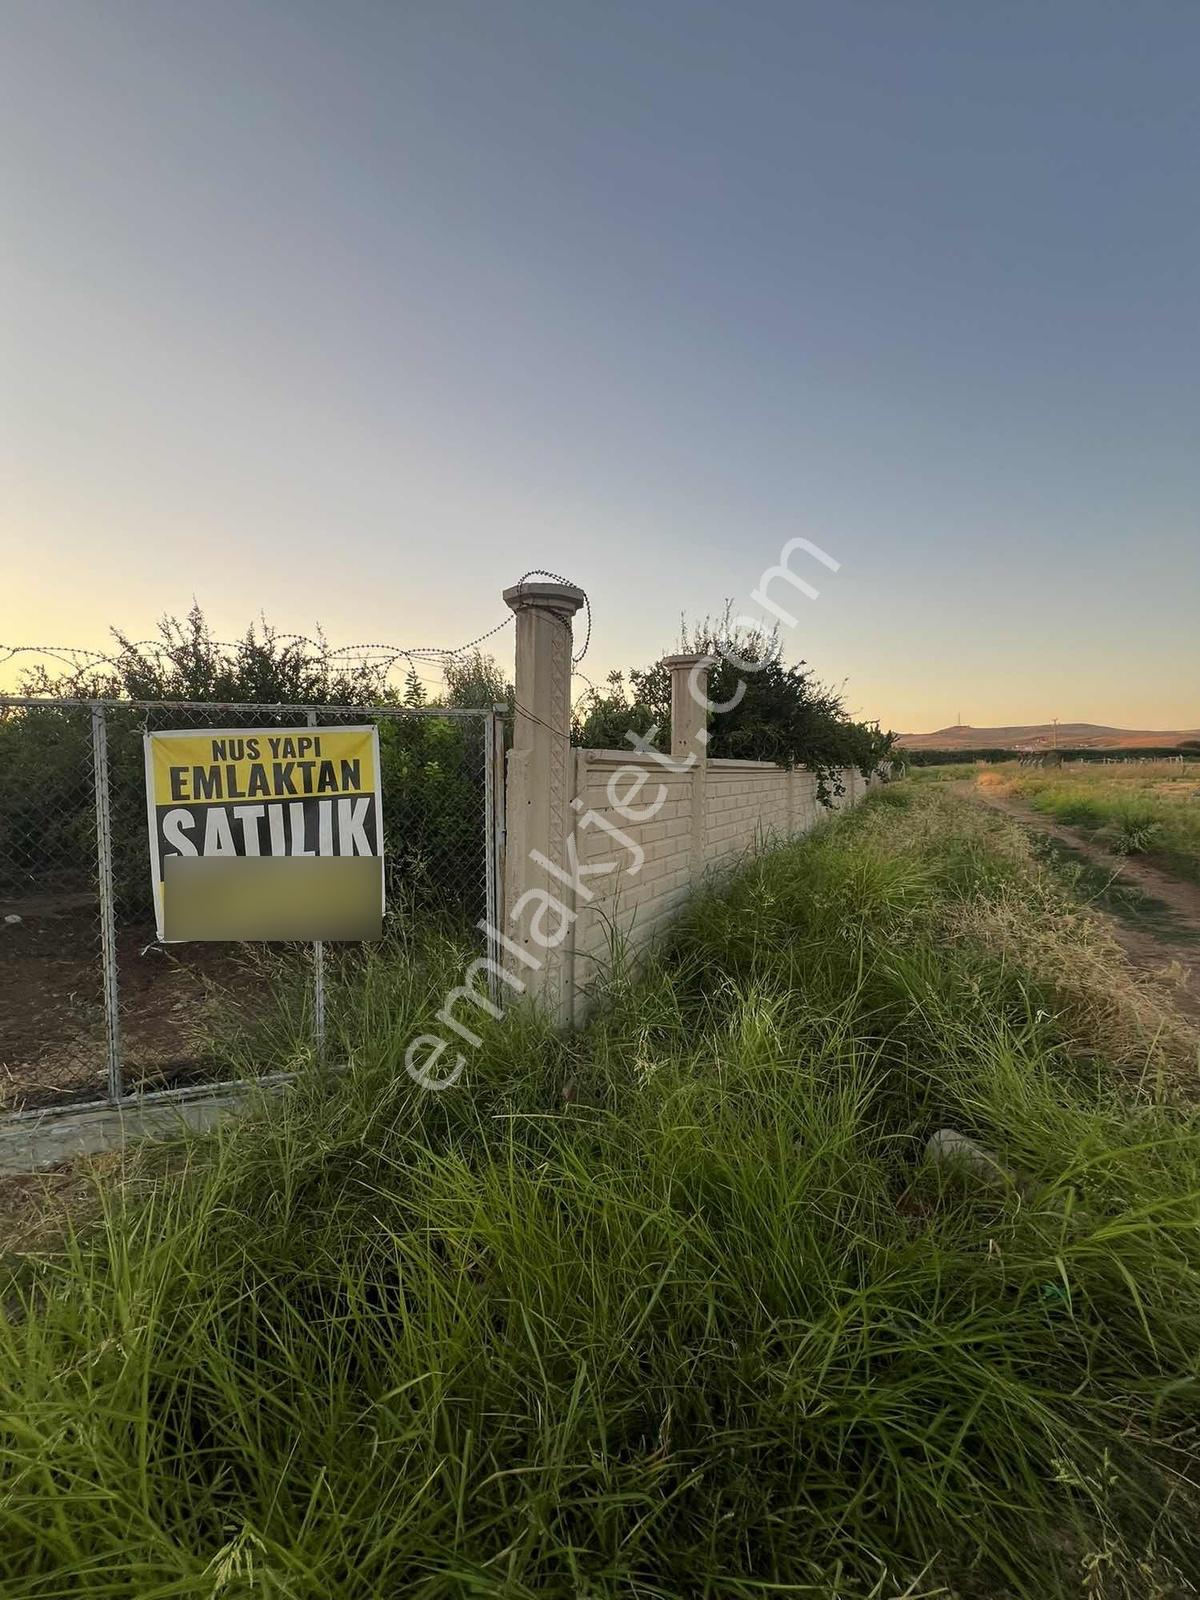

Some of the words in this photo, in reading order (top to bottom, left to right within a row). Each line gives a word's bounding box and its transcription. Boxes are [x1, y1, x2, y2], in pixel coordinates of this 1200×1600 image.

[211, 738, 261, 761] NUS
[268, 736, 321, 759] YAPI
[169, 759, 361, 801] EMLAKTAN
[162, 797, 374, 856] SATILIK
